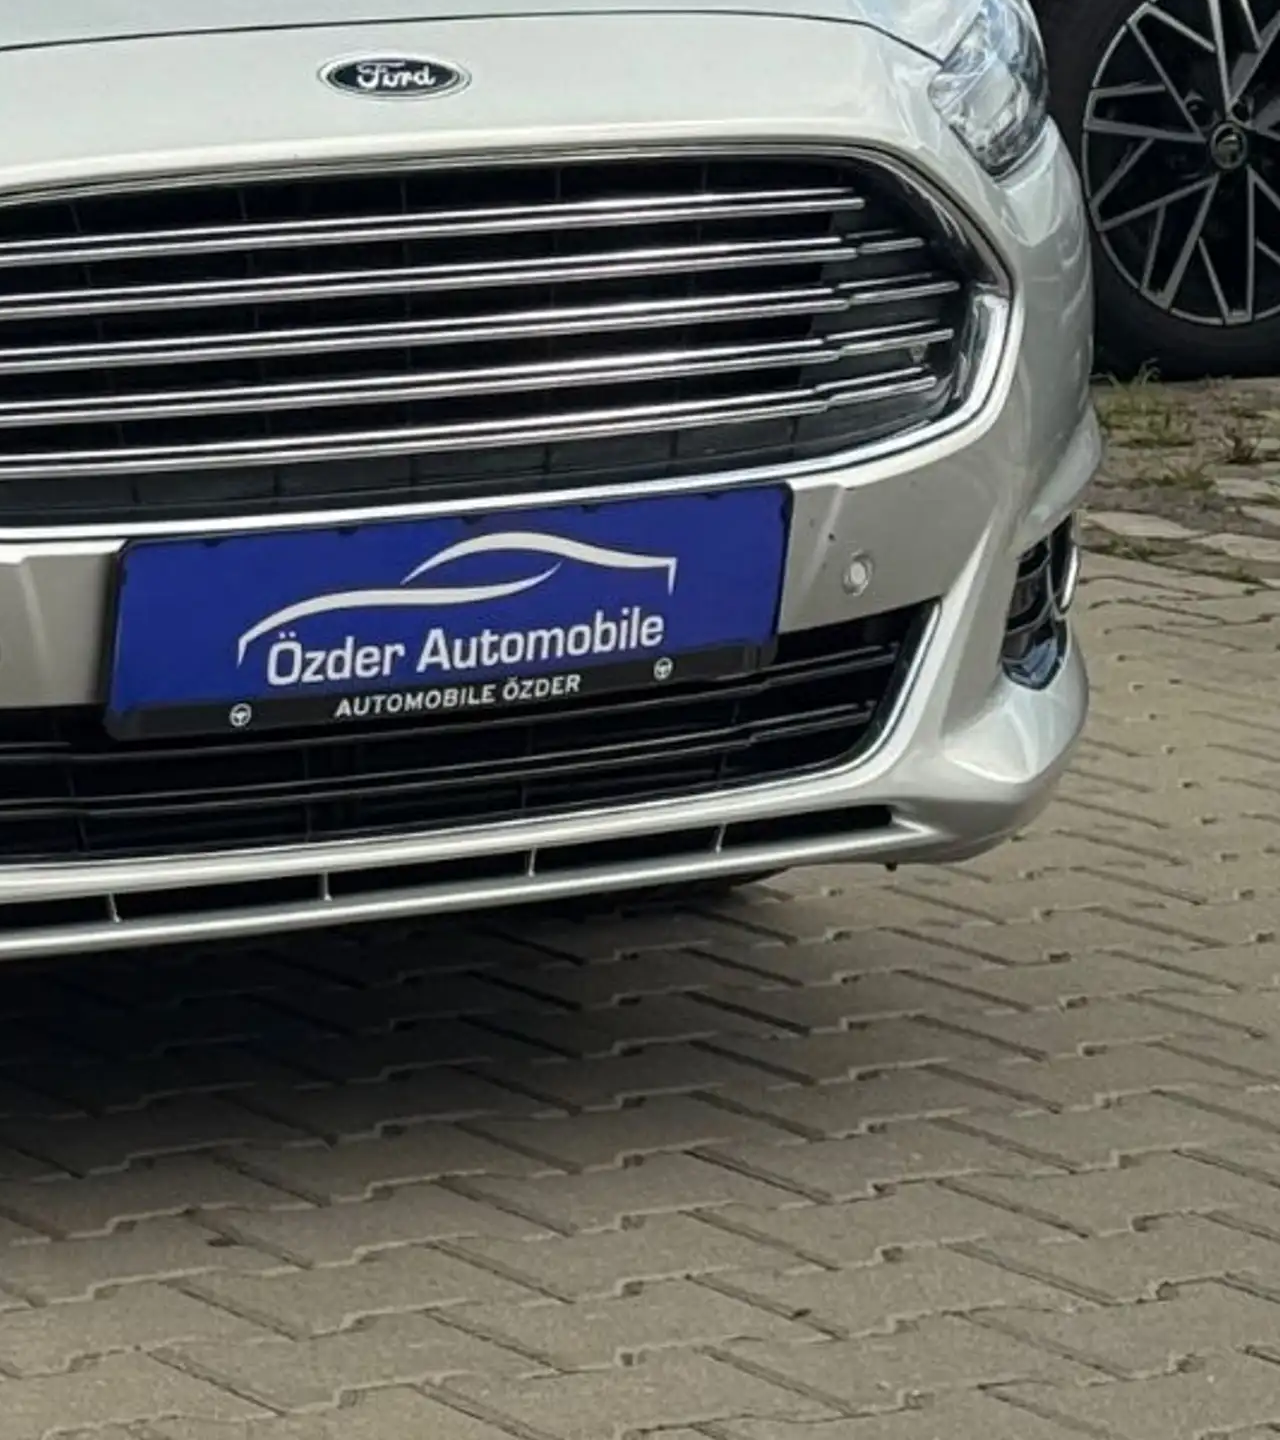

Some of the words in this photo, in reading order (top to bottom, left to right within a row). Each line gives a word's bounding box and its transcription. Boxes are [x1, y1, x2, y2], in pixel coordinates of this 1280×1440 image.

[355, 61, 437, 89] Ford
[266, 632, 407, 686] Özder
[416, 606, 666, 673] Automobile
[333, 684, 495, 720] AUTOMOBILE
[502, 674, 581, 707] ÖZDER
